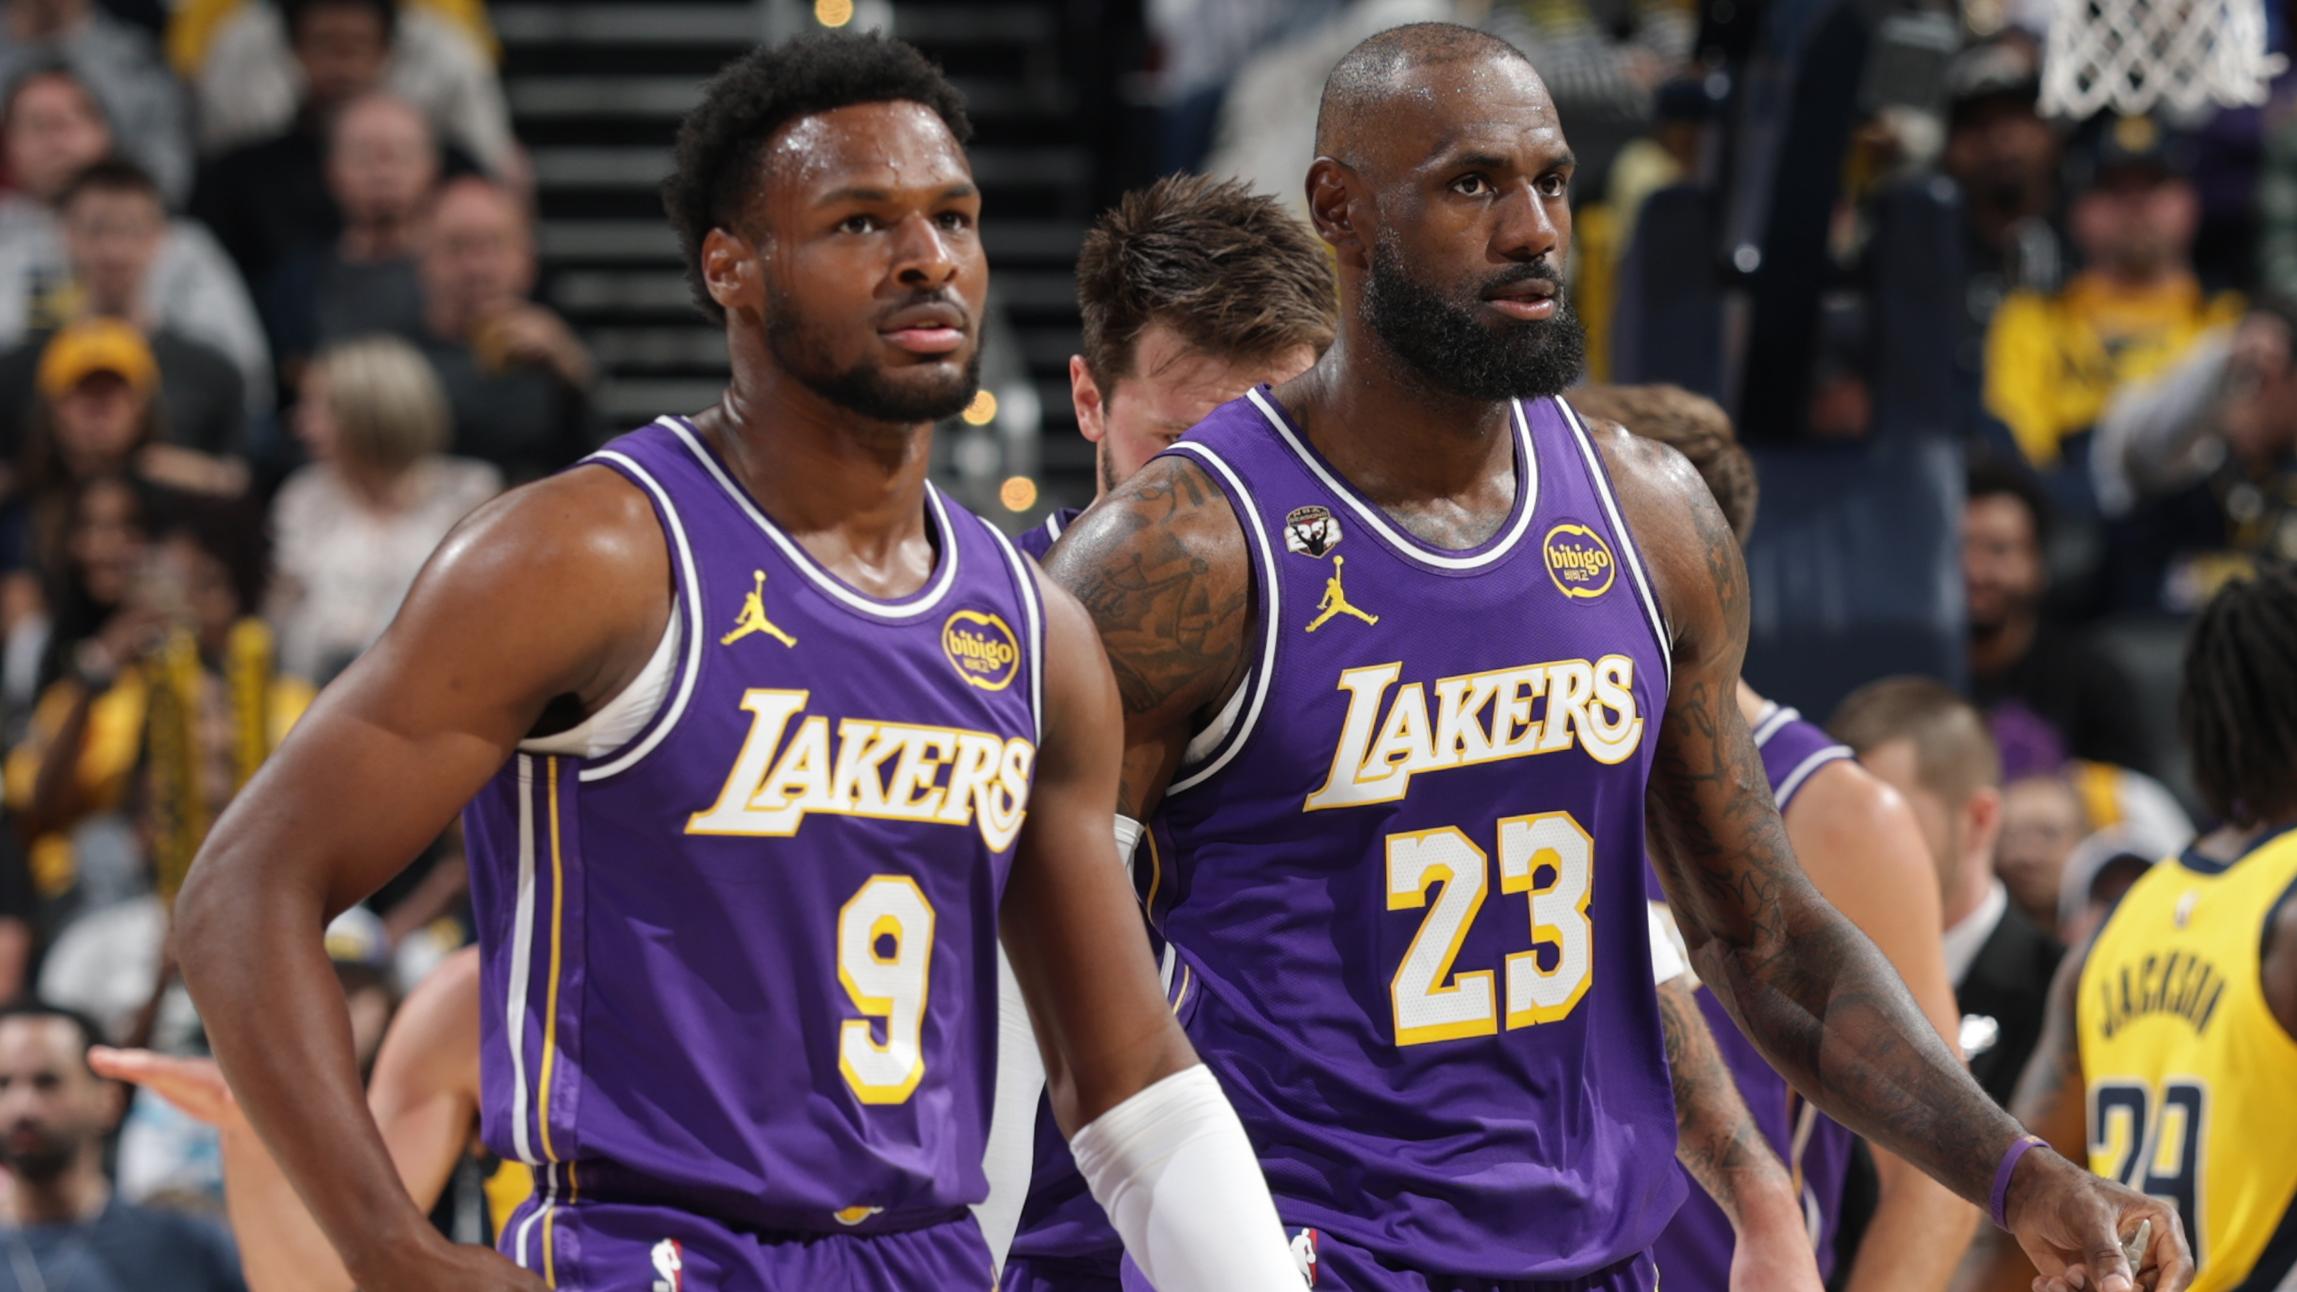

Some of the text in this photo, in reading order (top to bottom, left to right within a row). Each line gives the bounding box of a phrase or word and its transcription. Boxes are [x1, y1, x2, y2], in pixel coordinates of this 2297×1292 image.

[1549, 544, 1608, 576] bibigo
[949, 630, 1013, 670] bibigo
[684, 688, 1036, 853] LAKERS
[1303, 654, 1645, 811] LAKERS
[837, 874, 936, 1105] 9
[1386, 810, 1595, 1047] 23
[2101, 952, 2226, 1039] JACKSON
